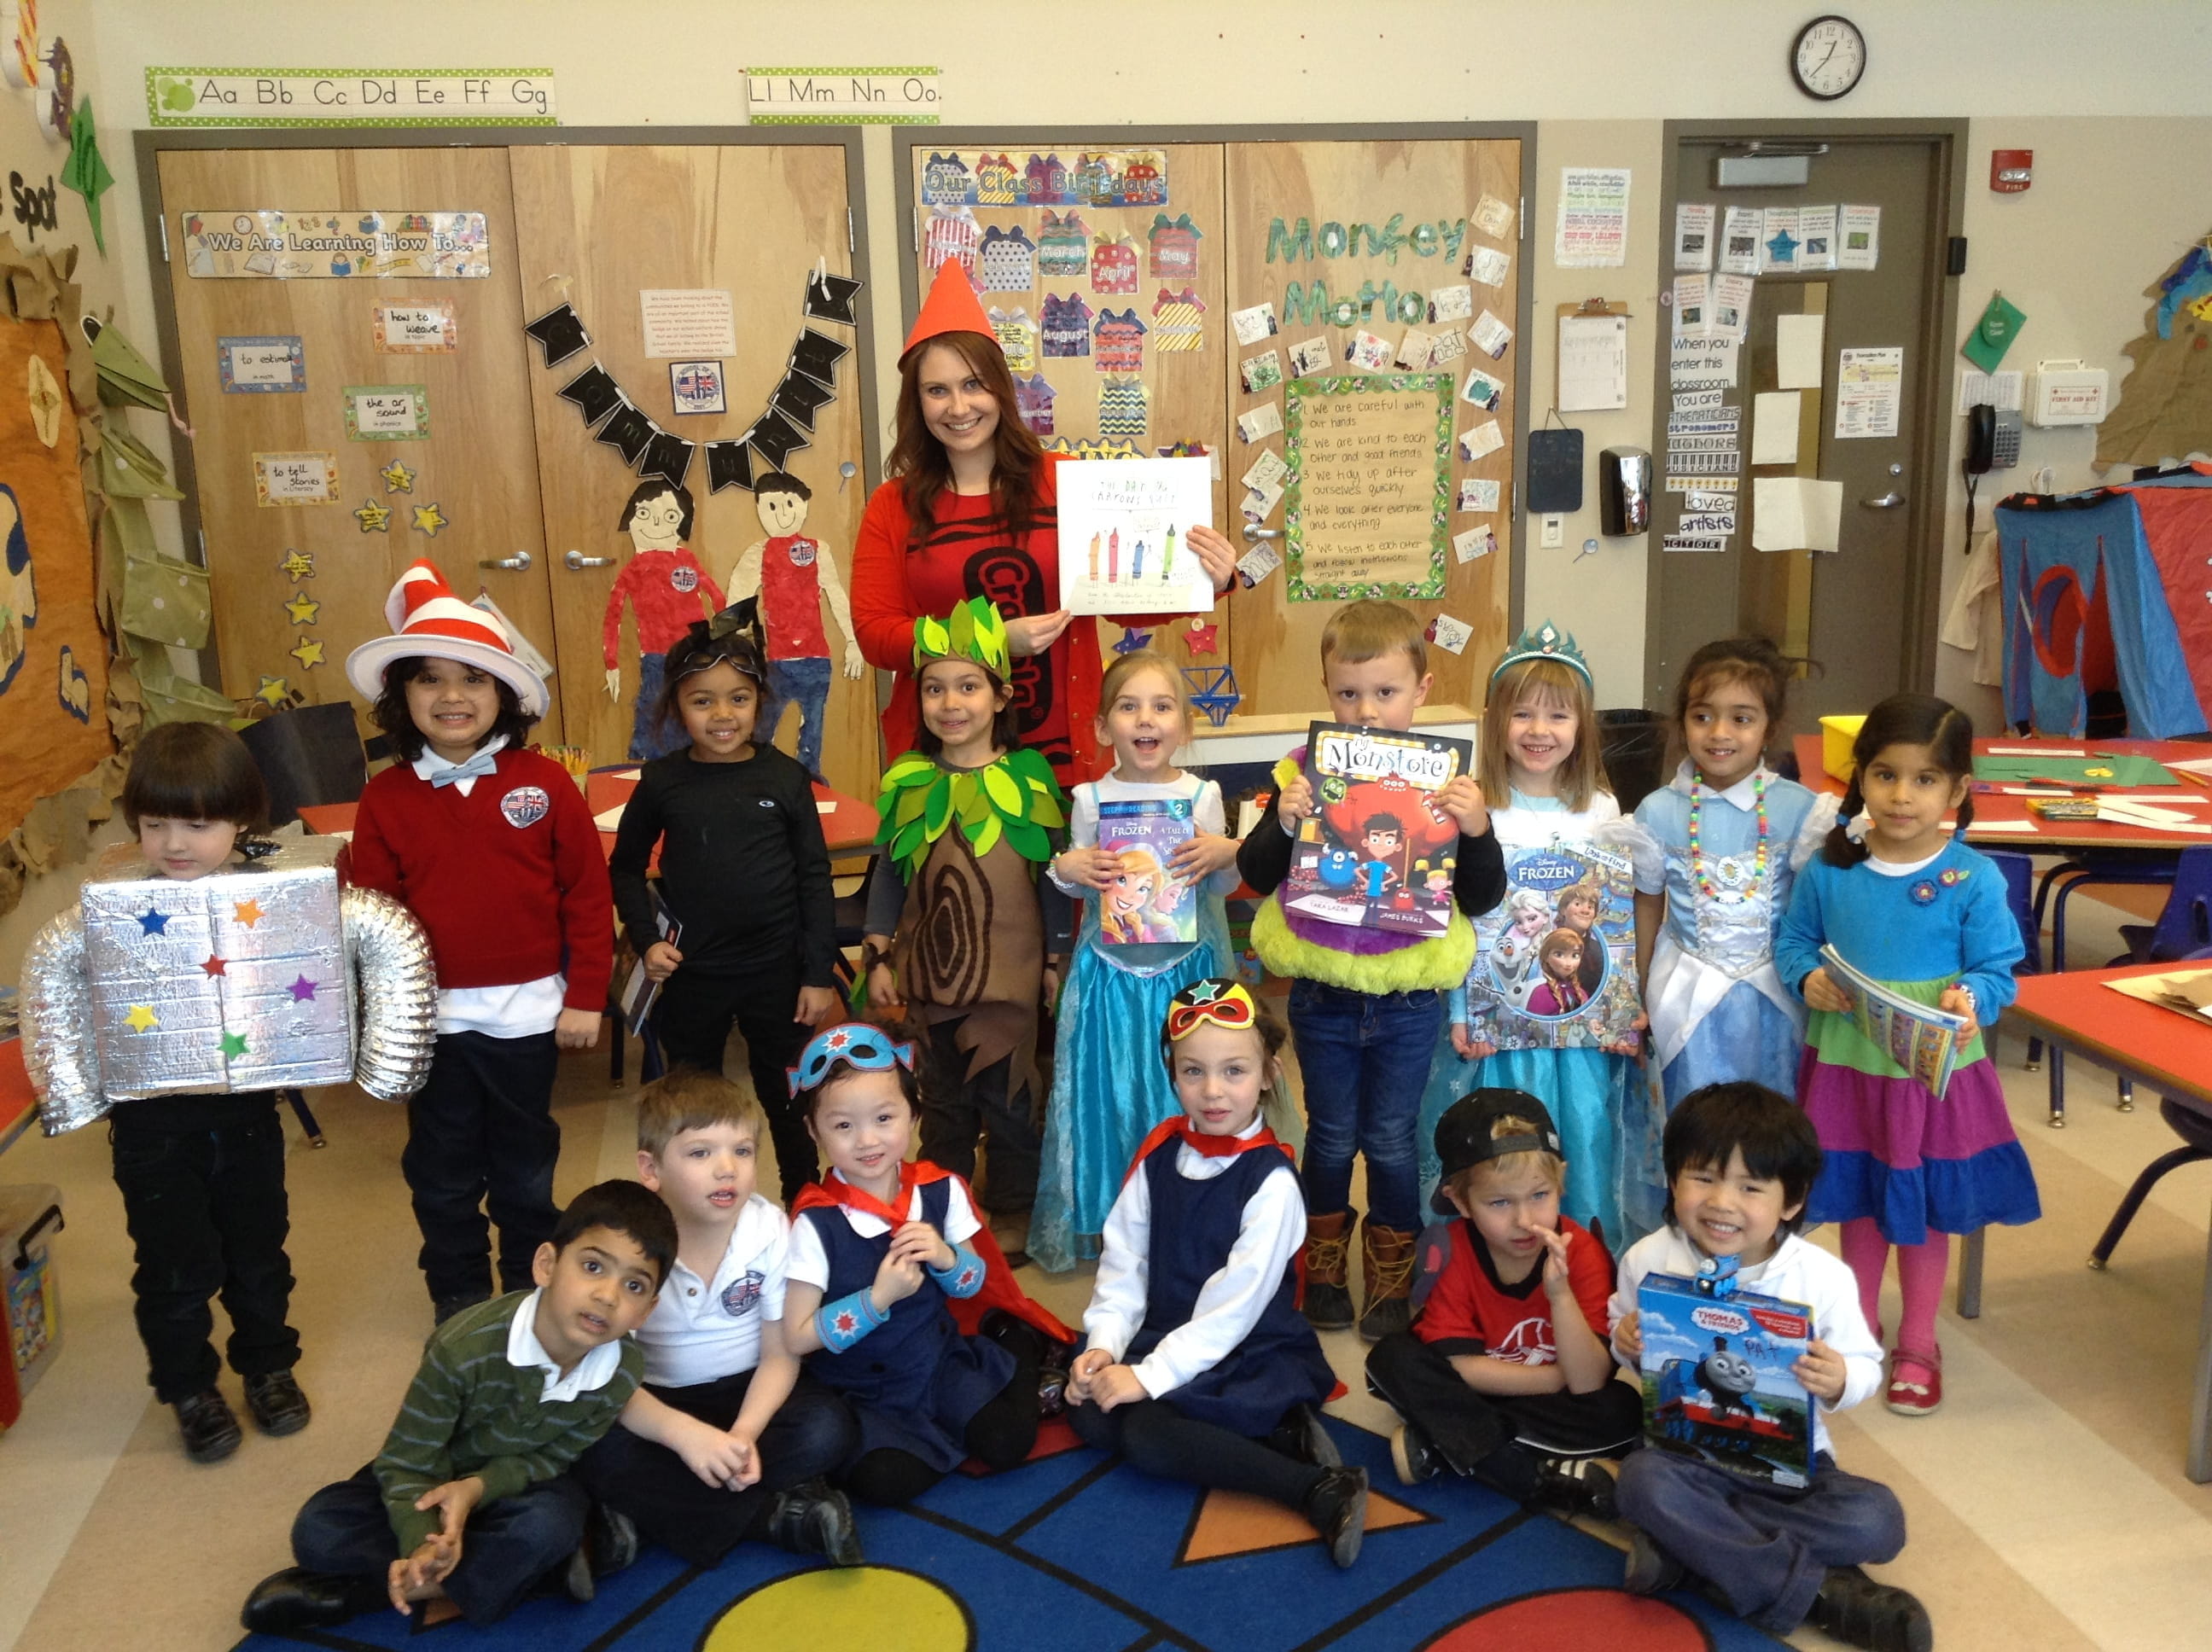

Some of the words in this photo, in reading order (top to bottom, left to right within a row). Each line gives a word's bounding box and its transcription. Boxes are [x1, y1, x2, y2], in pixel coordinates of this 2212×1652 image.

[199, 79, 236, 103] Aa
[256, 79, 293, 103] Bb
[313, 80, 347, 104] Cc
[362, 80, 396, 103] Dd
[416, 80, 445, 103] Ee
[465, 80, 490, 103] Ff
[511, 79, 546, 113] Gg
[789, 78, 834, 102] Mm
[853, 78, 885, 102] Nn
[904, 78, 936, 102] Oo
[924, 171, 970, 193] Our
[981, 171, 1043, 194] Class
[9, 171, 58, 243] Spot
[208, 233, 242, 251] We
[248, 233, 282, 251] Are
[289, 233, 376, 256] Learning
[384, 233, 426, 251] How
[1266, 213, 1466, 266] Monkey
[1040, 246, 1086, 258] March
[1159, 248, 1190, 264] May
[1098, 265, 1131, 282] April
[1283, 280, 1426, 329] Motto
[391, 310, 410, 322] how
[416, 311, 429, 322] to
[405, 324, 440, 334] weave
[1043, 329, 1089, 342] August
[1673, 338, 1706, 351] When
[1708, 338, 1730, 354] you
[242, 354, 252, 365] to
[1671, 358, 1701, 370] enter
[1704, 356, 1723, 369] this
[366, 398, 384, 409] the
[1674, 394, 1697, 407] You
[1699, 392, 1722, 404] are
[375, 406, 407, 417] sound
[1313, 404, 1330, 415] We
[1335, 404, 1353, 414] are
[1359, 399, 1398, 412] careful
[1404, 400, 1425, 410] with
[1310, 420, 1325, 428] our
[1330, 416, 1357, 428] hands
[1301, 438, 1309, 449] 2
[1314, 437, 1330, 449] We
[1336, 437, 1353, 448] are
[1359, 433, 1380, 445] kind
[1386, 433, 1398, 444] to
[1403, 433, 1426, 444] each
[1668, 438, 1737, 450] UTHORS
[1342, 451, 1359, 462] and
[273, 468, 284, 478] to
[288, 464, 308, 478] tell
[1302, 469, 1310, 480] 3
[1336, 469, 1360, 486] tidy
[1367, 468, 1380, 480] up
[1386, 466, 1418, 478] after
[289, 476, 320, 486] stories
[1313, 485, 1362, 496] ourselves
[1368, 483, 1405, 497] quickly
[1686, 493, 1736, 511] loved
[1304, 503, 1311, 516] 4
[1336, 504, 1355, 514] look
[1388, 504, 1424, 515] everyone
[1309, 521, 1327, 531] and
[1332, 518, 1381, 531] everything
[1679, 515, 1734, 532] artists
[1306, 541, 1313, 551] 5
[1337, 544, 1363, 555] listen
[1366, 542, 1376, 552] to
[1379, 540, 1399, 550] each
[1313, 559, 1327, 568] and
[1360, 555, 1408, 565] instructions
[1328, 741, 1445, 777] Monstore
[1174, 803, 1184, 816] 2
[1112, 825, 1152, 837] FROZEN
[1535, 858, 1558, 867] Disney
[1518, 864, 1575, 882] FROZEN
[1697, 1310, 1743, 1327] THOMAS
